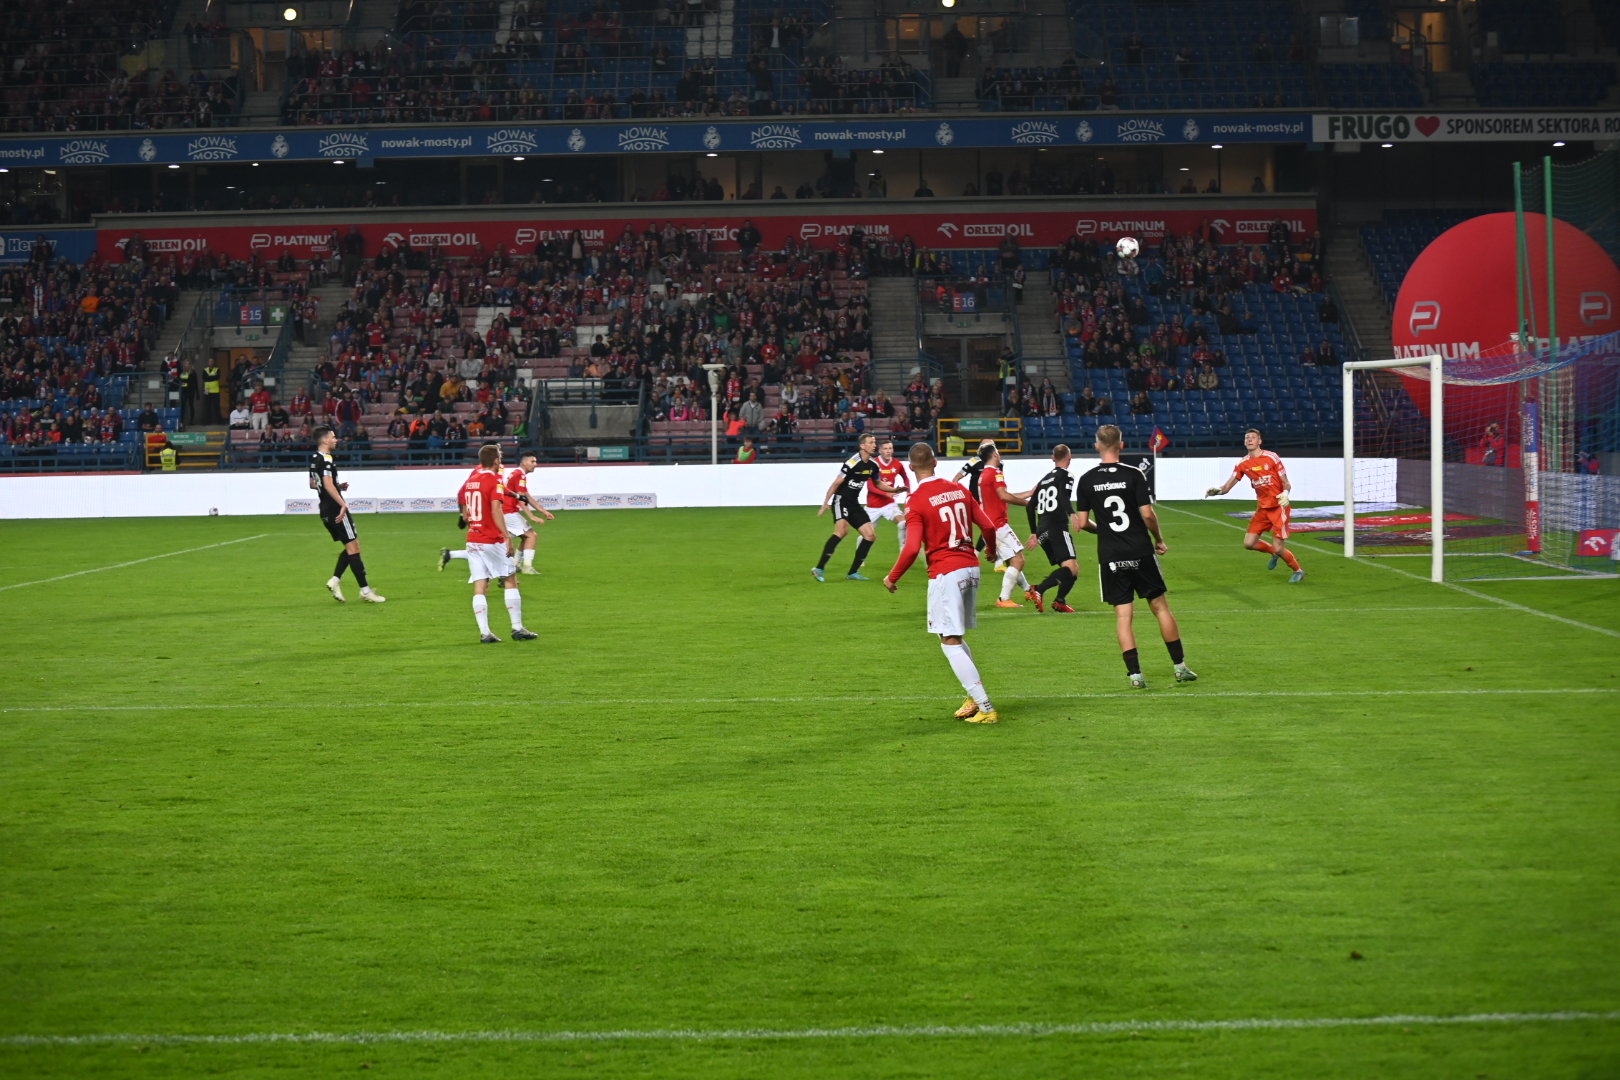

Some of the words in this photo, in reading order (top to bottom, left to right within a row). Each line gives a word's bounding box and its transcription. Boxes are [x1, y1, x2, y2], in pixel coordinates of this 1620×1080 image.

[751, 125, 800, 140] NOWAK
[1011, 121, 1057, 136] NOWAK
[1118, 119, 1163, 135] NOWAK
[1213, 121, 1304, 134] nowak-mosty.pl
[1328, 115, 1410, 140] FRUGO
[1446, 118, 1533, 134] SPONSOREM
[1537, 117, 1600, 133] SEKTORA
[487, 129, 536, 145] NOWAK
[618, 126, 668, 142] NOWAK
[814, 129, 906, 141] nowak-mosty.pl
[1016, 136, 1055, 144] MOSTY
[1122, 133, 1160, 142] MOSTY
[60, 139, 108, 155] NOWAK
[188, 136, 237, 152] NOWAK
[319, 133, 368, 149] NOWAK
[381, 136, 472, 149] nowak-mosty.pl
[623, 141, 664, 150] MOSTY
[756, 140, 796, 149] MOSTY
[324, 148, 364, 157] MOSTY
[492, 144, 532, 153] MOSTY
[65, 155, 104, 164] MOSTY
[193, 151, 233, 160] MOSTY
[824, 225, 890, 236] PLATNUM
[965, 225, 1004, 235] ORLEN
[1007, 224, 1034, 237] OIL
[1100, 220, 1165, 232] PLATINUM
[274, 235, 331, 246] PLATINU
[453, 233, 480, 246] OIL
[953, 297, 960, 308] E
[962, 297, 975, 308] 16
[241, 311, 247, 320] E
[249, 310, 262, 320] 15
[1037, 485, 1058, 515] 88
[1103, 495, 1130, 533] 3
[939, 501, 972, 548] 20
